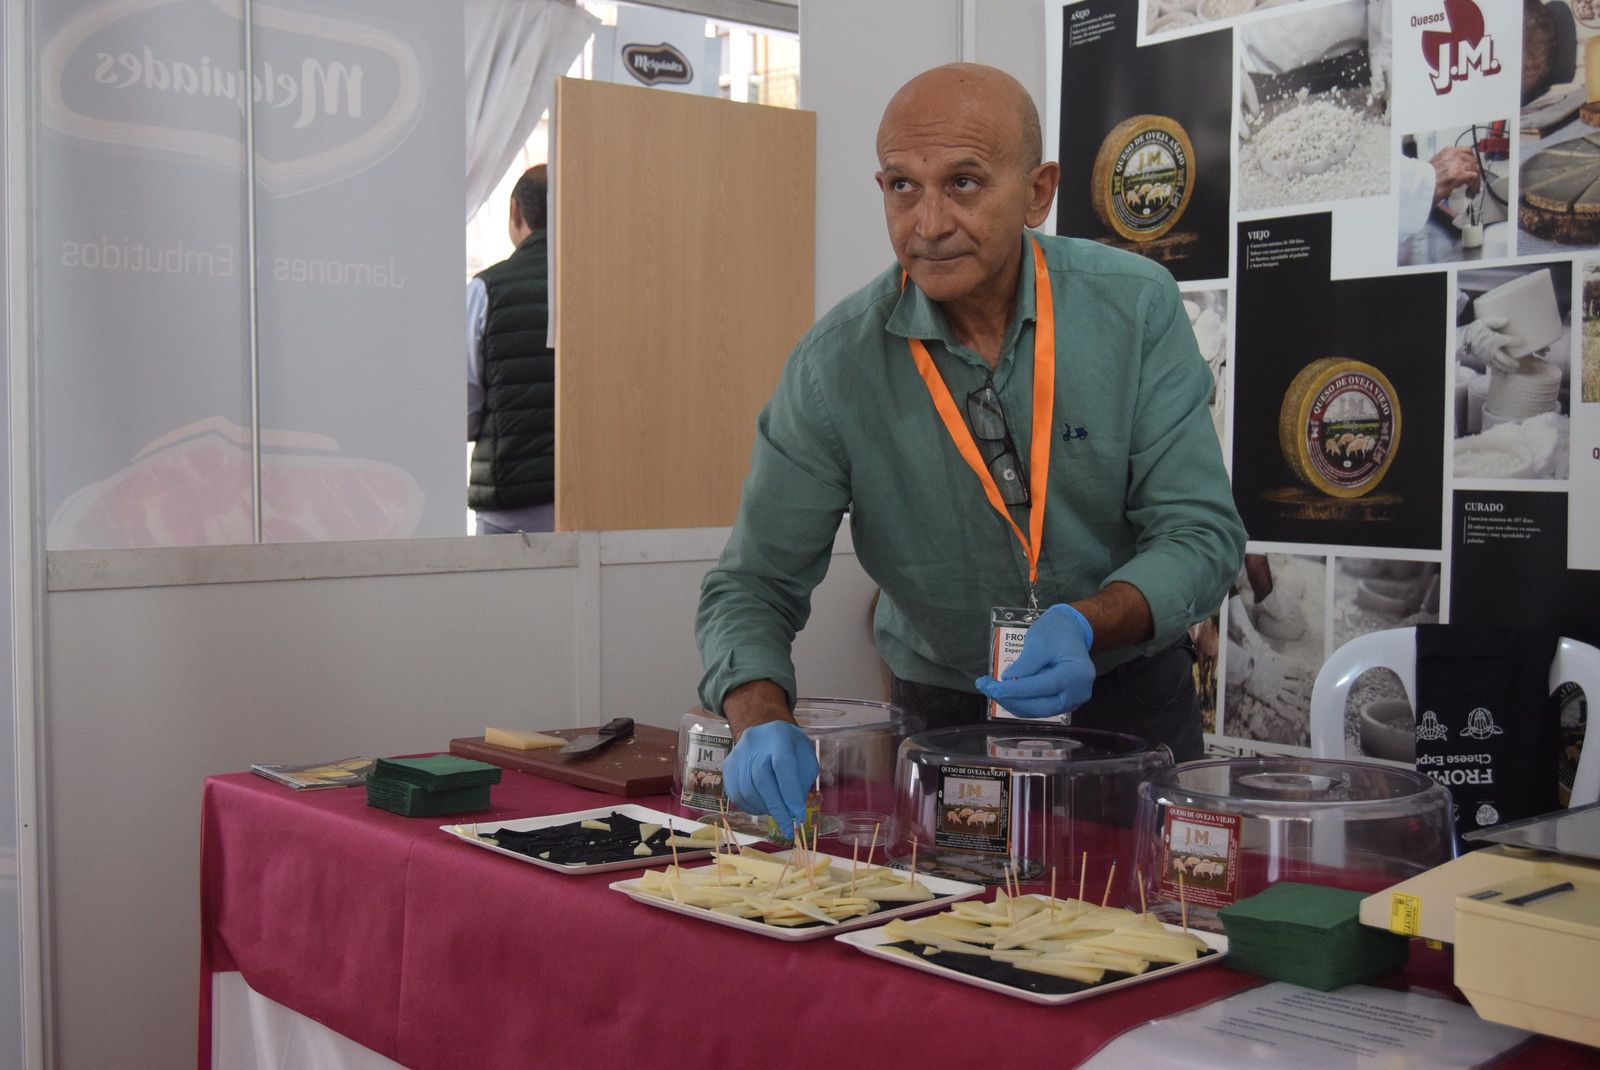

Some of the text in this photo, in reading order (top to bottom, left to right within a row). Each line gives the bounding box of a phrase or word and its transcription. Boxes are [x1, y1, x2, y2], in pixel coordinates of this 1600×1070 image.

[1410, 12, 1445, 27] Quesos
[1429, 34, 1501, 96] J.M.
[1115, 144, 1134, 172] QUESO
[1134, 136, 1145, 146] DE
[1145, 131, 1169, 143] OVEJA
[1247, 229, 1270, 241] VIEJO
[1313, 376, 1390, 415] QUESO DE OVEJA VIEJO
[1464, 502, 1504, 512] CURADO
[1005, 633, 1025, 641] FRO
[1447, 753, 1491, 765] Cheese
[941, 766, 958, 774] QUESO
[958, 767, 966, 775] DE
[967, 768, 986, 776] OVEJA
[1427, 768, 1493, 785] FROM
[1169, 808, 1187, 816] QUESO
[1195, 813, 1215, 821] OVEJA
[1215, 816, 1236, 824] VIEJO
